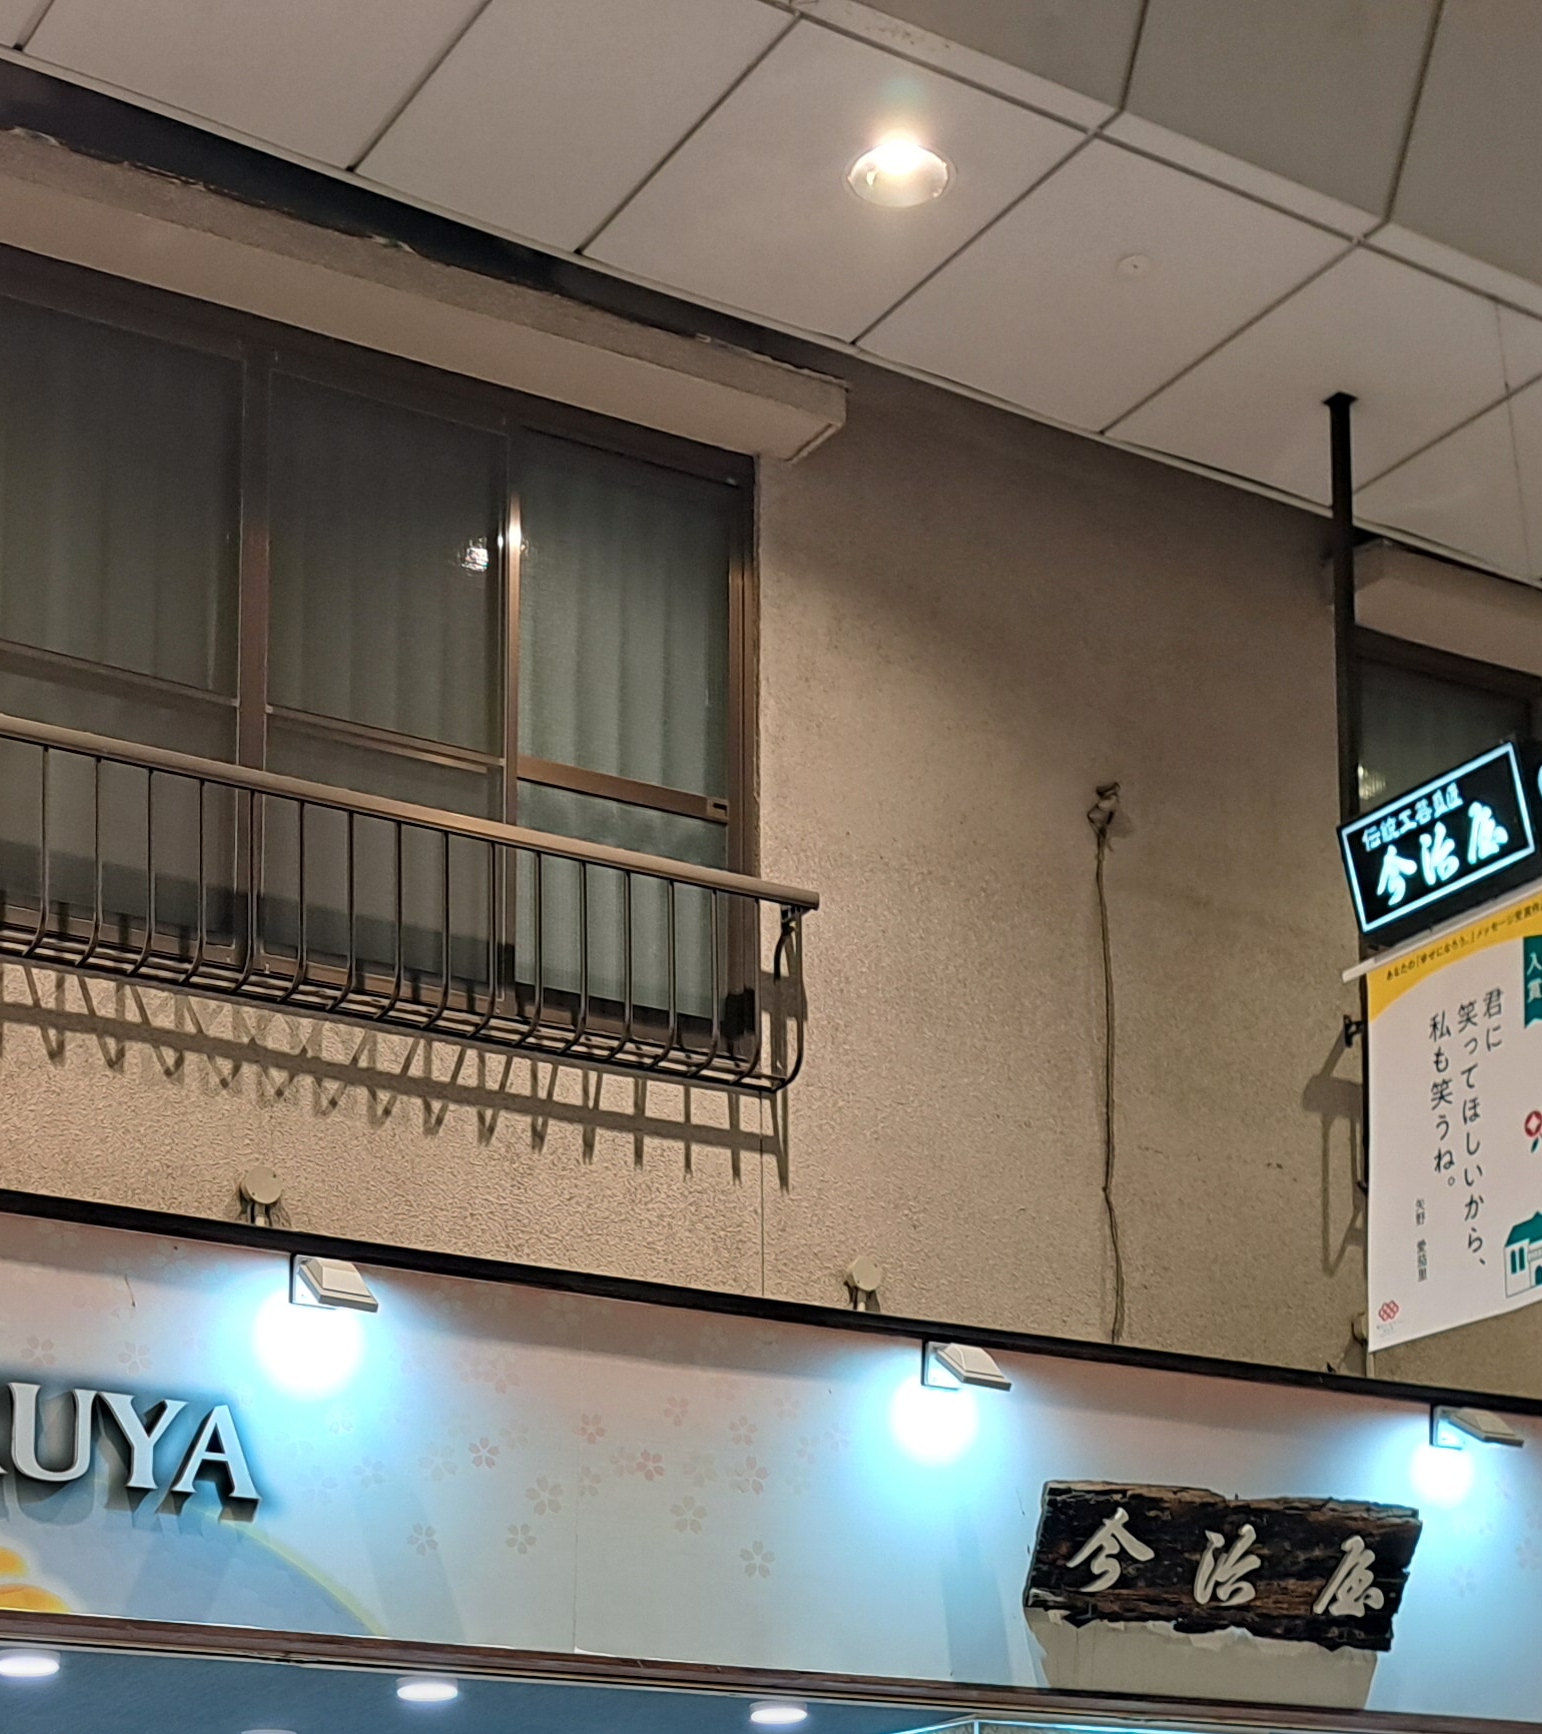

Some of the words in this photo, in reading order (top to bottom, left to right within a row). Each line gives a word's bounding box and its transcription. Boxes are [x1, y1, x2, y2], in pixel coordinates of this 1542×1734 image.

[1376, 801, 1509, 907] 今治屋
[1482, 988, 1504, 1052] 君に
[1526, 952, 1542, 1003] 入賞
[1428, 1010, 1456, 1187] 私も笑うね。
[1457, 1000, 1487, 1266] 笑ってほしいから、
[1066, 1507, 1384, 1618] 今治屋
